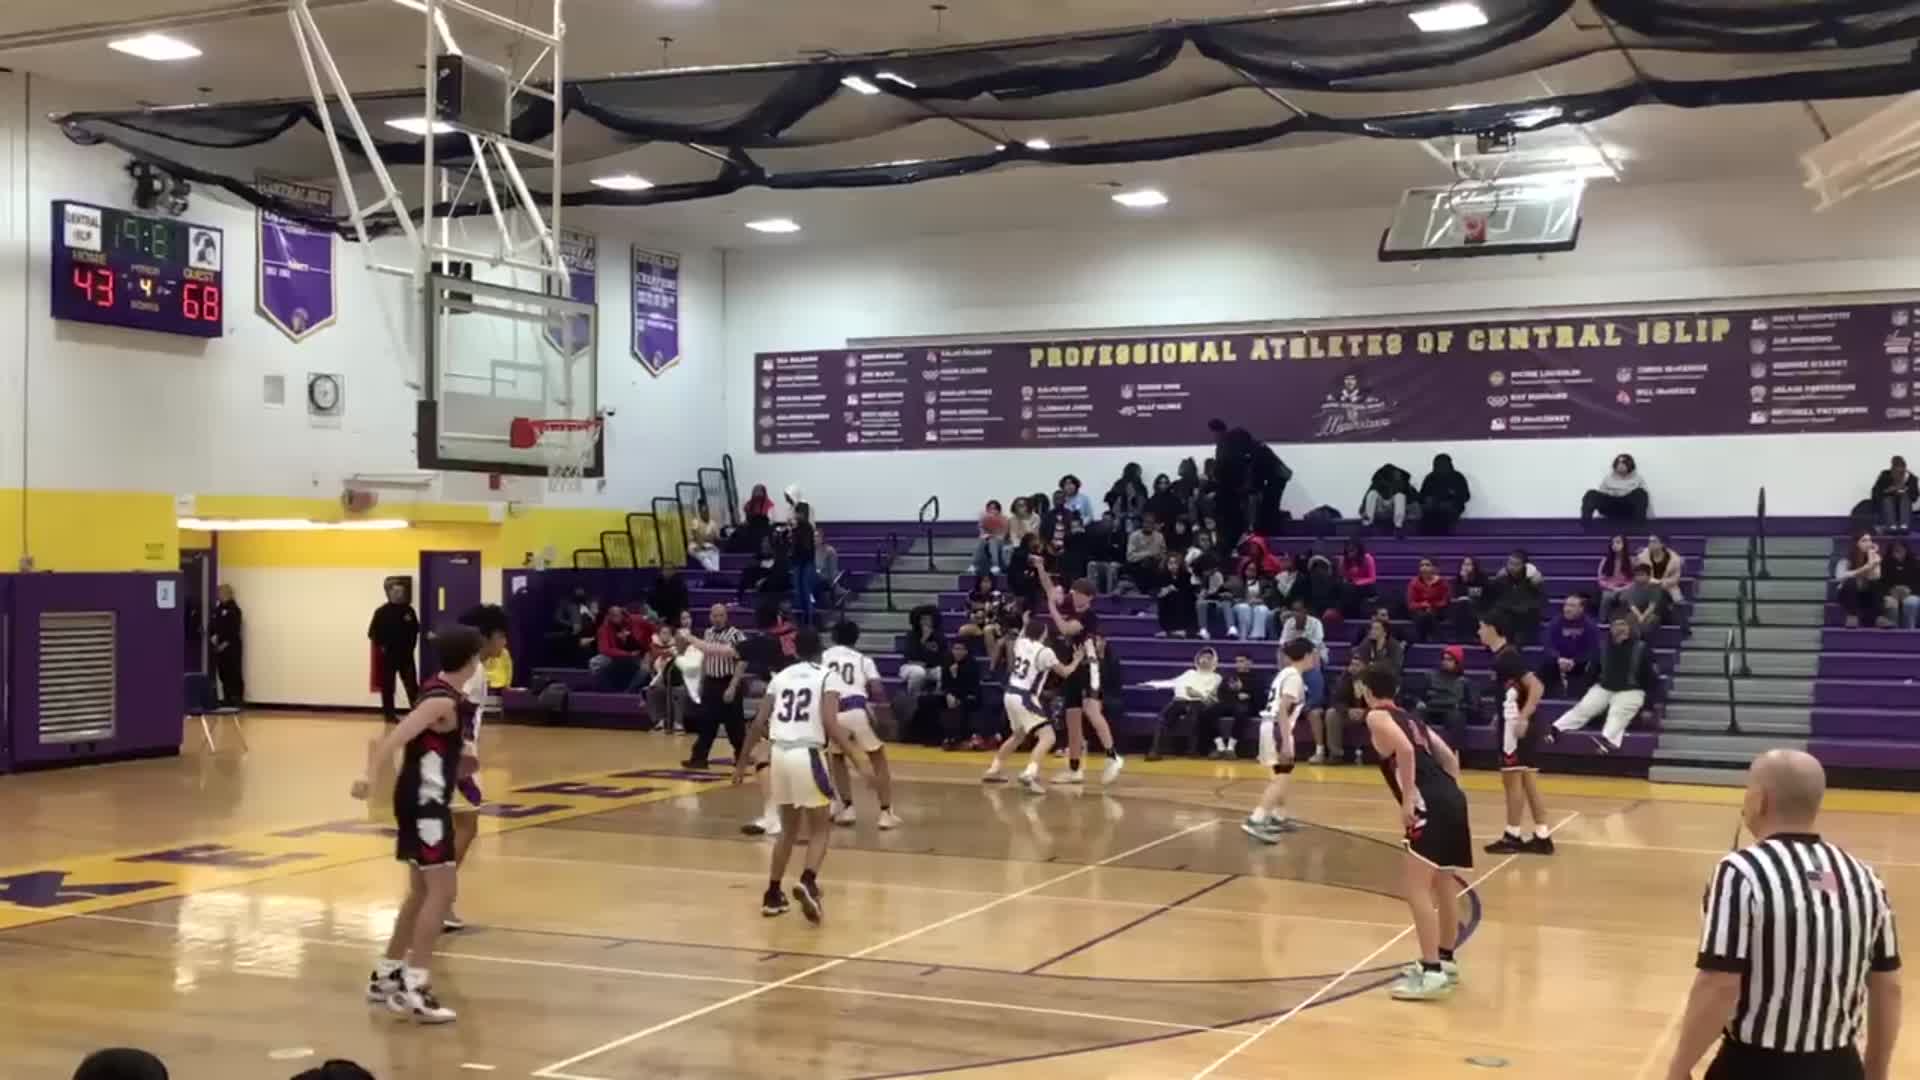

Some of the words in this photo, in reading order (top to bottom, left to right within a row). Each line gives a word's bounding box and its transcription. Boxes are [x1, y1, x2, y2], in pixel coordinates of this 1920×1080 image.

[73, 267, 114, 307] 43
[139, 278, 152, 297] 4
[183, 283, 219, 321] 68
[1030, 340, 1236, 368] PROFESSIONAL
[1251, 333, 1402, 361] ATHLETES
[1417, 330, 1453, 354] OF
[1467, 322, 1622, 351] CENTRAL
[1637, 318, 1731, 345] ISLIP
[1014, 656, 1031, 679] 23
[778, 688, 812, 722] 32
